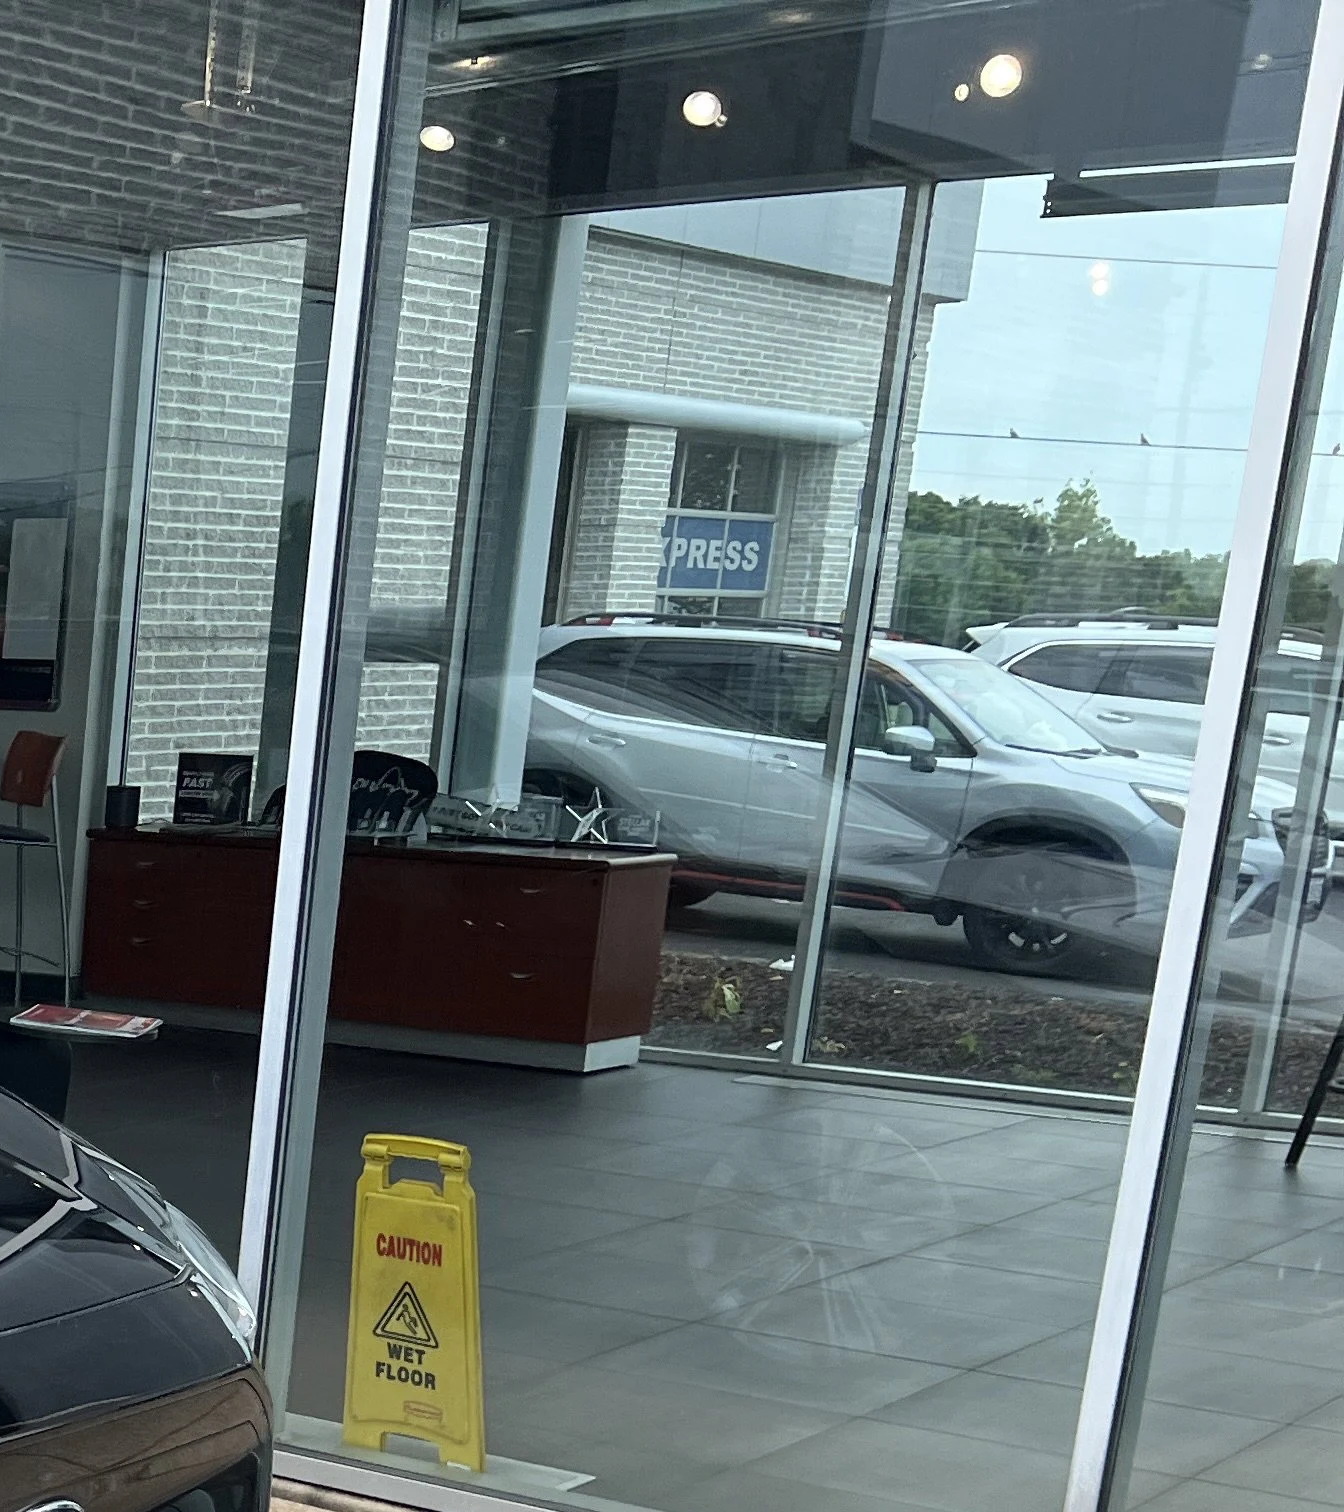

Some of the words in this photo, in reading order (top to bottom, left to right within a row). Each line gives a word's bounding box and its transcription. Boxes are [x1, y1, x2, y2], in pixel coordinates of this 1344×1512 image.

[376, 1234, 442, 1266] CAUTION
[388, 1342, 425, 1365] WET
[376, 1361, 436, 1390] FLOOR
